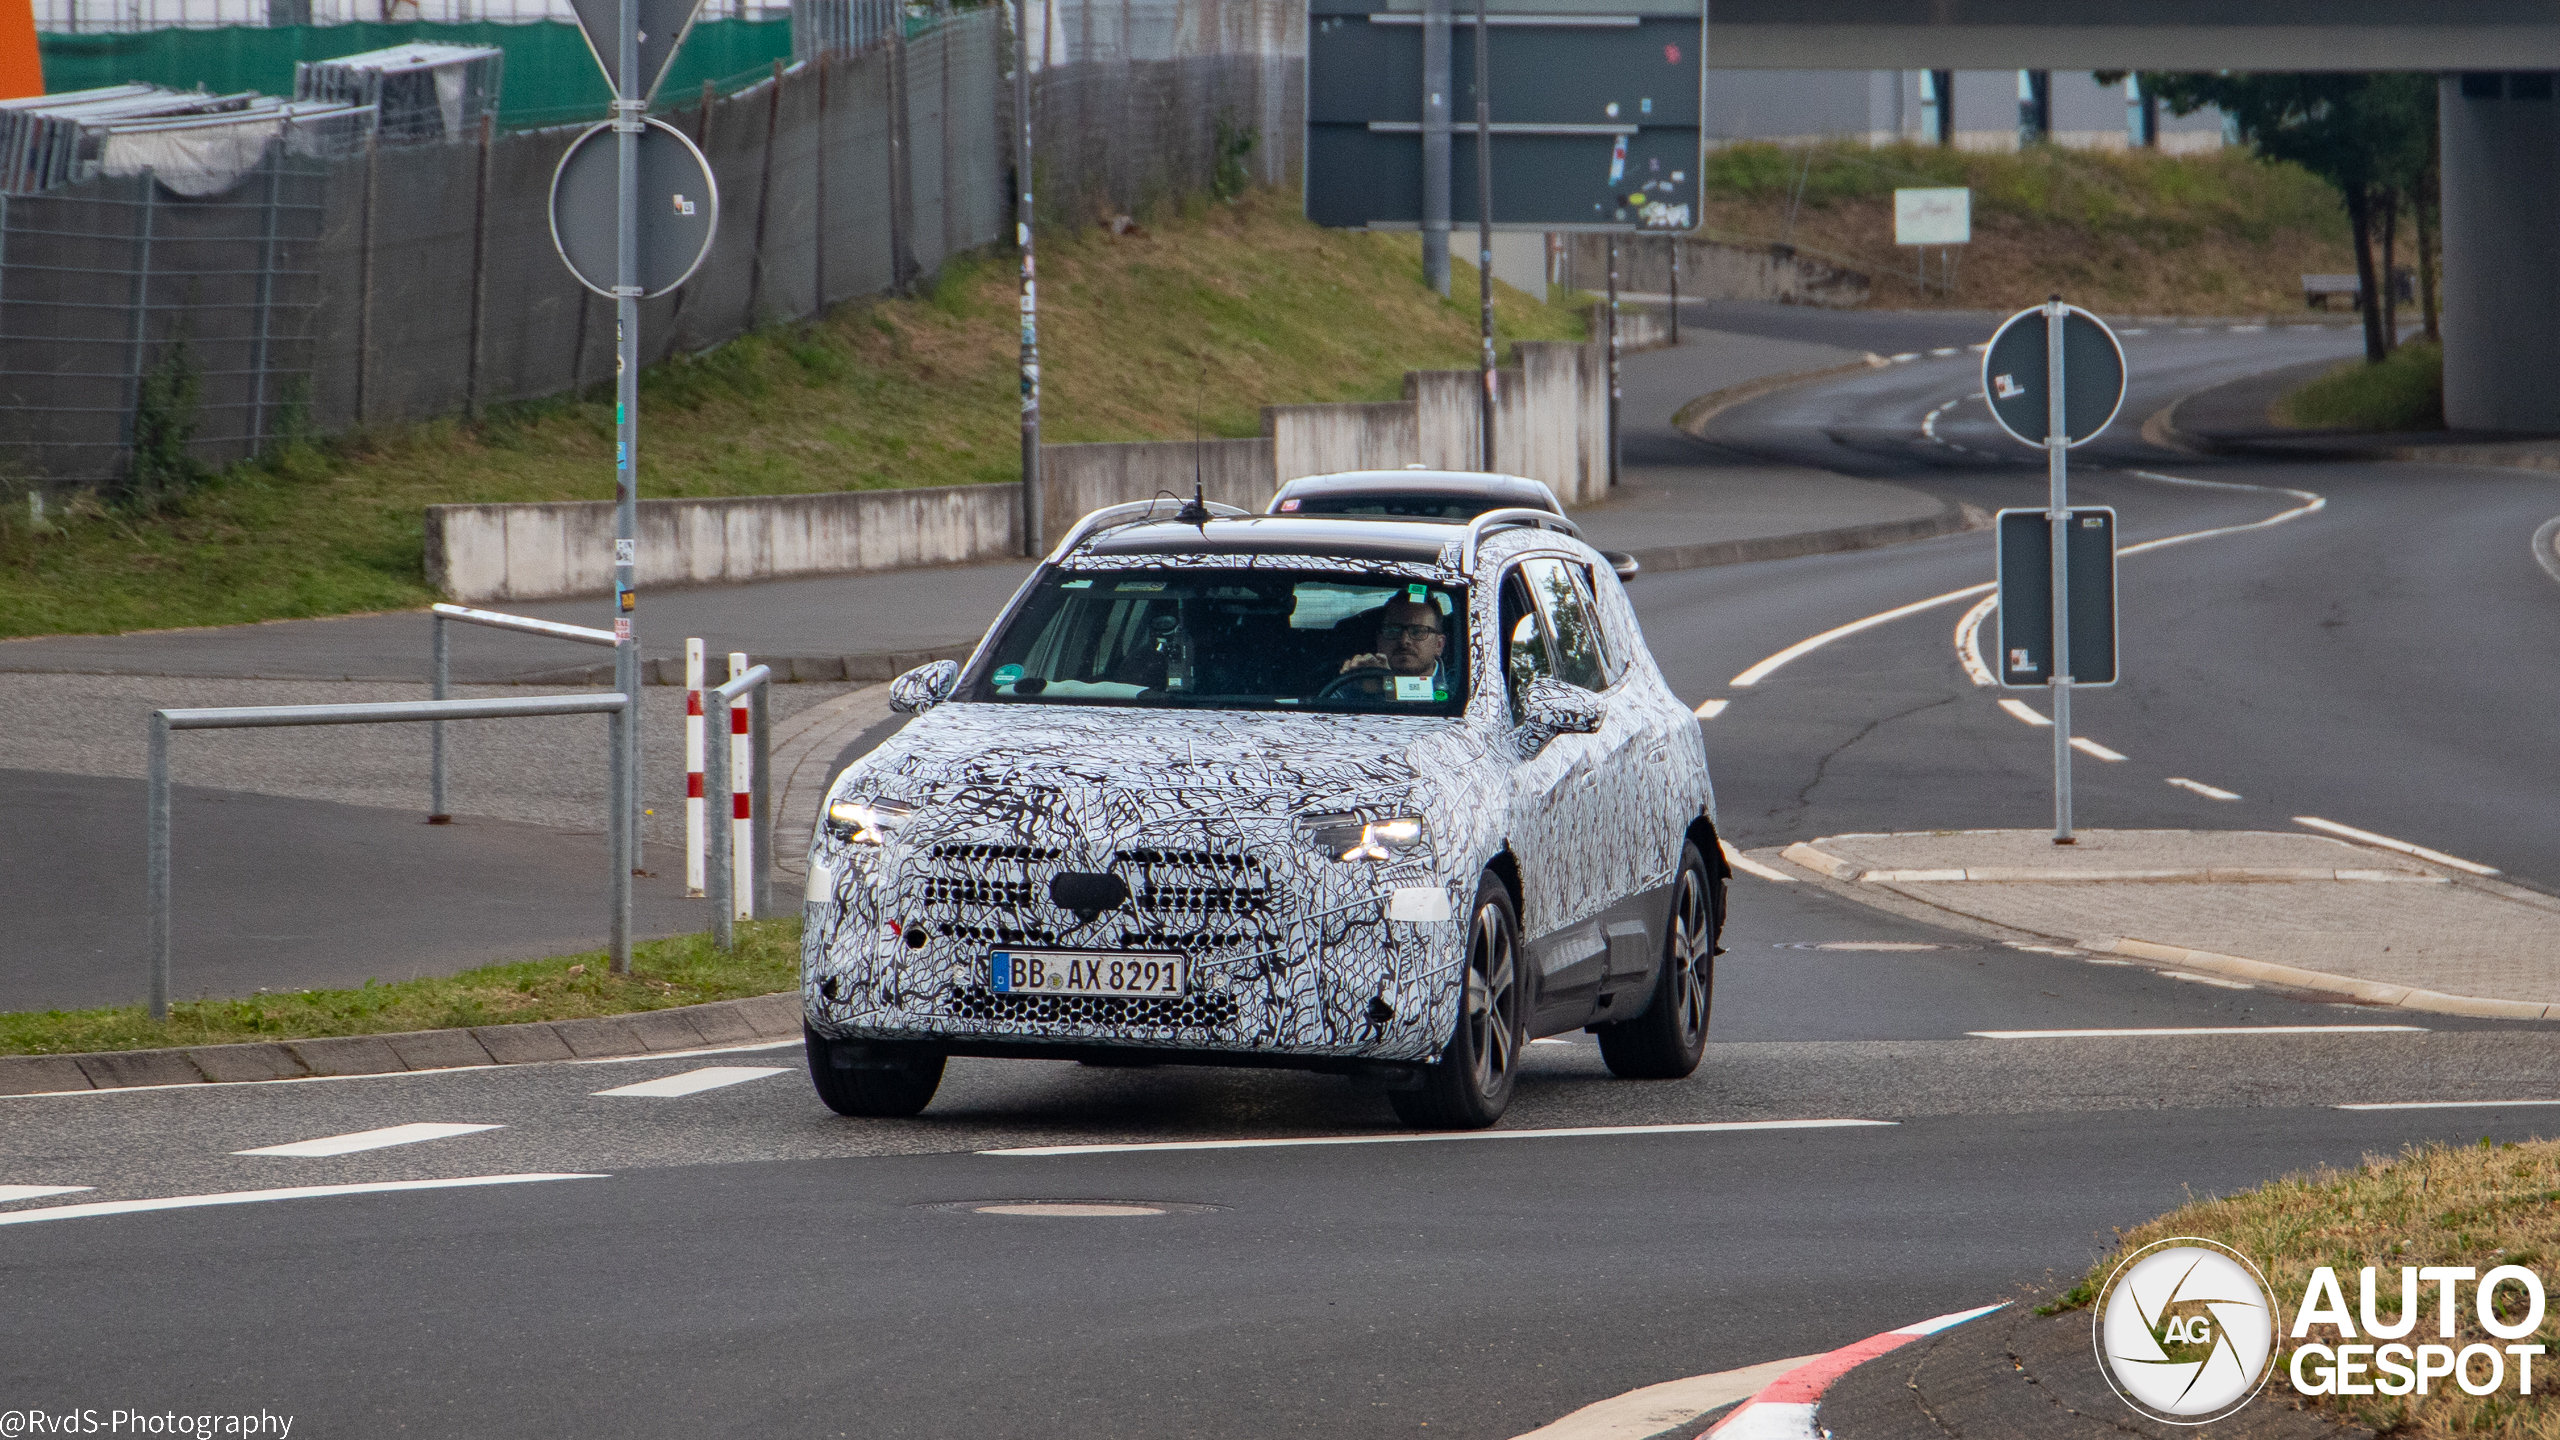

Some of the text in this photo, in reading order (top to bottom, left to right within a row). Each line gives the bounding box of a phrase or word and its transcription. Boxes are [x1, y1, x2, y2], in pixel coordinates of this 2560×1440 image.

[1011, 958, 1177, 992] BB AX 8291
